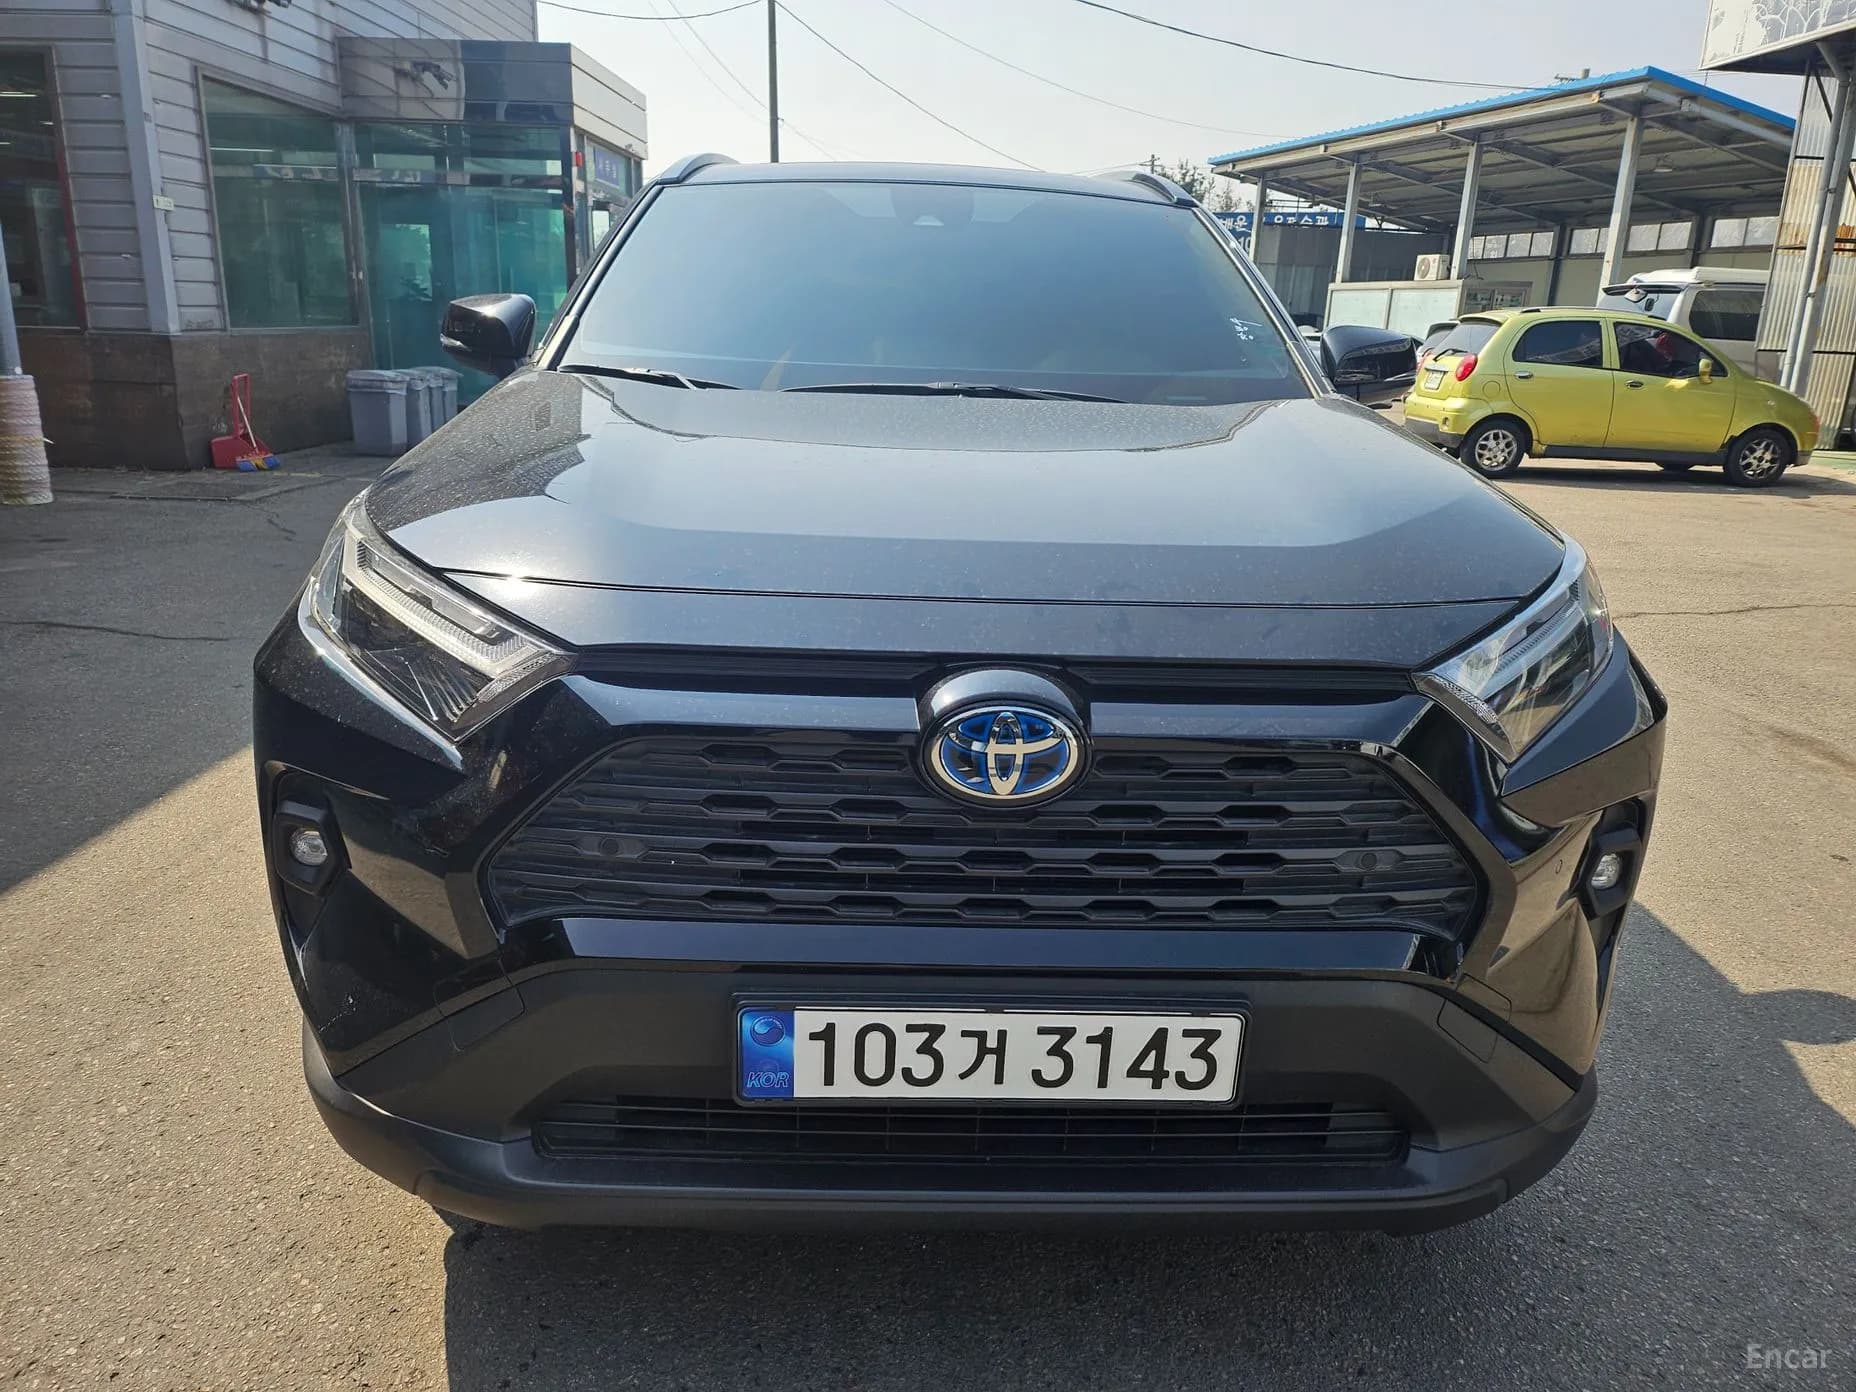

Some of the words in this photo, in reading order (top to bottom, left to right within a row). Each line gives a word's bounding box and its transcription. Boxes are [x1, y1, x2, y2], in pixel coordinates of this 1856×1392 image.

[808, 1022, 1007, 1087] 103거
[1031, 1026, 1222, 1091] 3143
[747, 1071, 790, 1088] KOR
